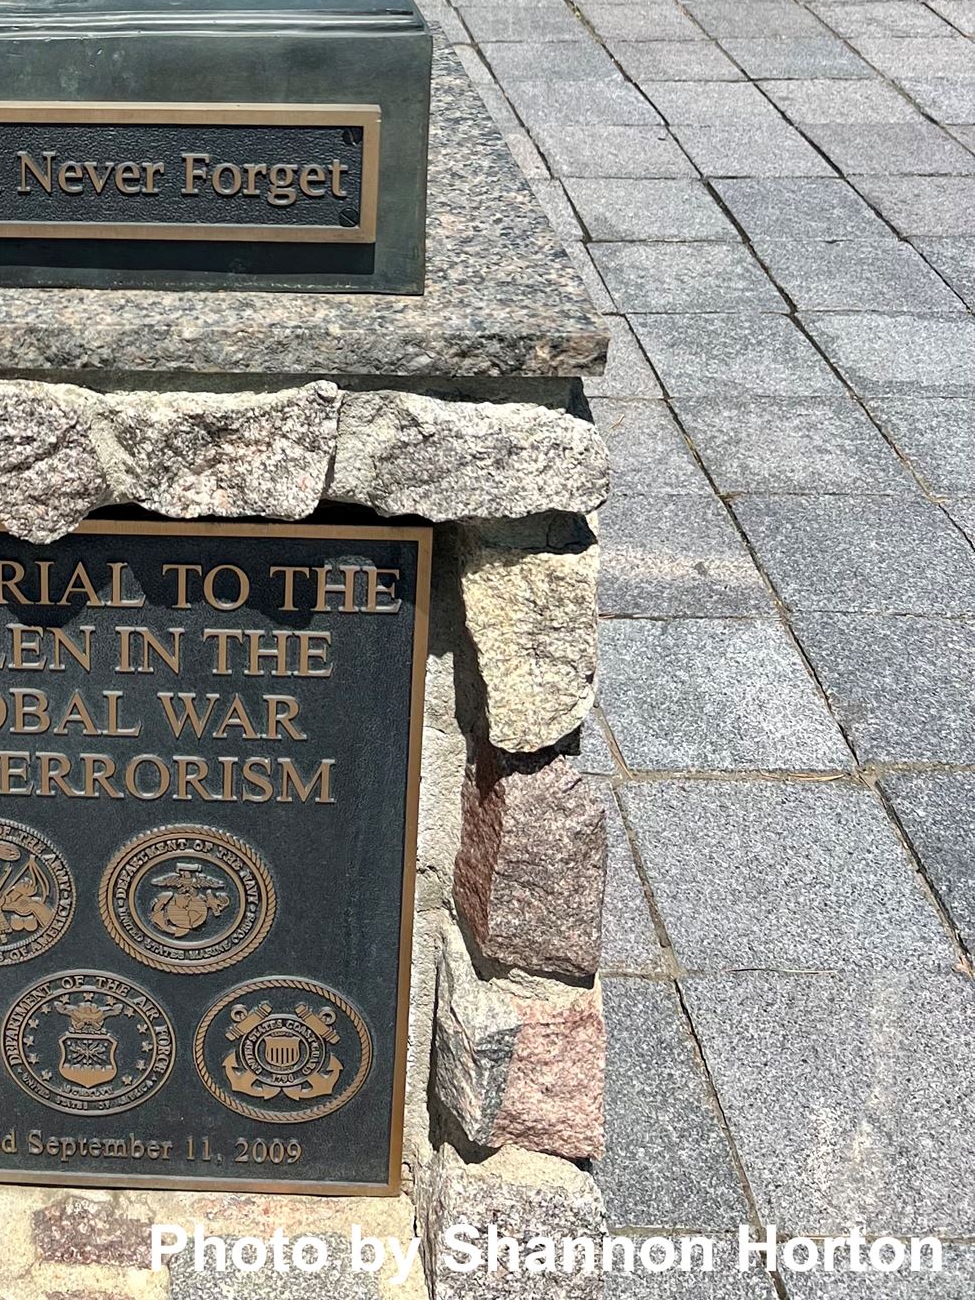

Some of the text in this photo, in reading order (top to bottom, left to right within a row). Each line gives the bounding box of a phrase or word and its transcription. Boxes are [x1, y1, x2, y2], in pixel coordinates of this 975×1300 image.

[17, 150, 165, 195] Never
[181, 153, 349, 206] Forget
[162, 564, 250, 610] TO
[269, 565, 402, 613] THE
[114, 626, 185, 674] IN
[203, 628, 334, 677] THE
[157, 692, 307, 740] WAR
[18, 830, 46, 853] THE
[43, 853, 72, 891] ARMY
[193, 840, 213, 852] OF
[217, 847, 243, 871] THE
[10, 949, 27, 960] OF
[61, 975, 85, 989] OF
[96, 976, 130, 997] THE
[133, 996, 160, 1021] AIR
[28, 1130, 173, 1161] September
[185, 1136, 224, 1166] 11,
[234, 1137, 303, 1164] 2009
